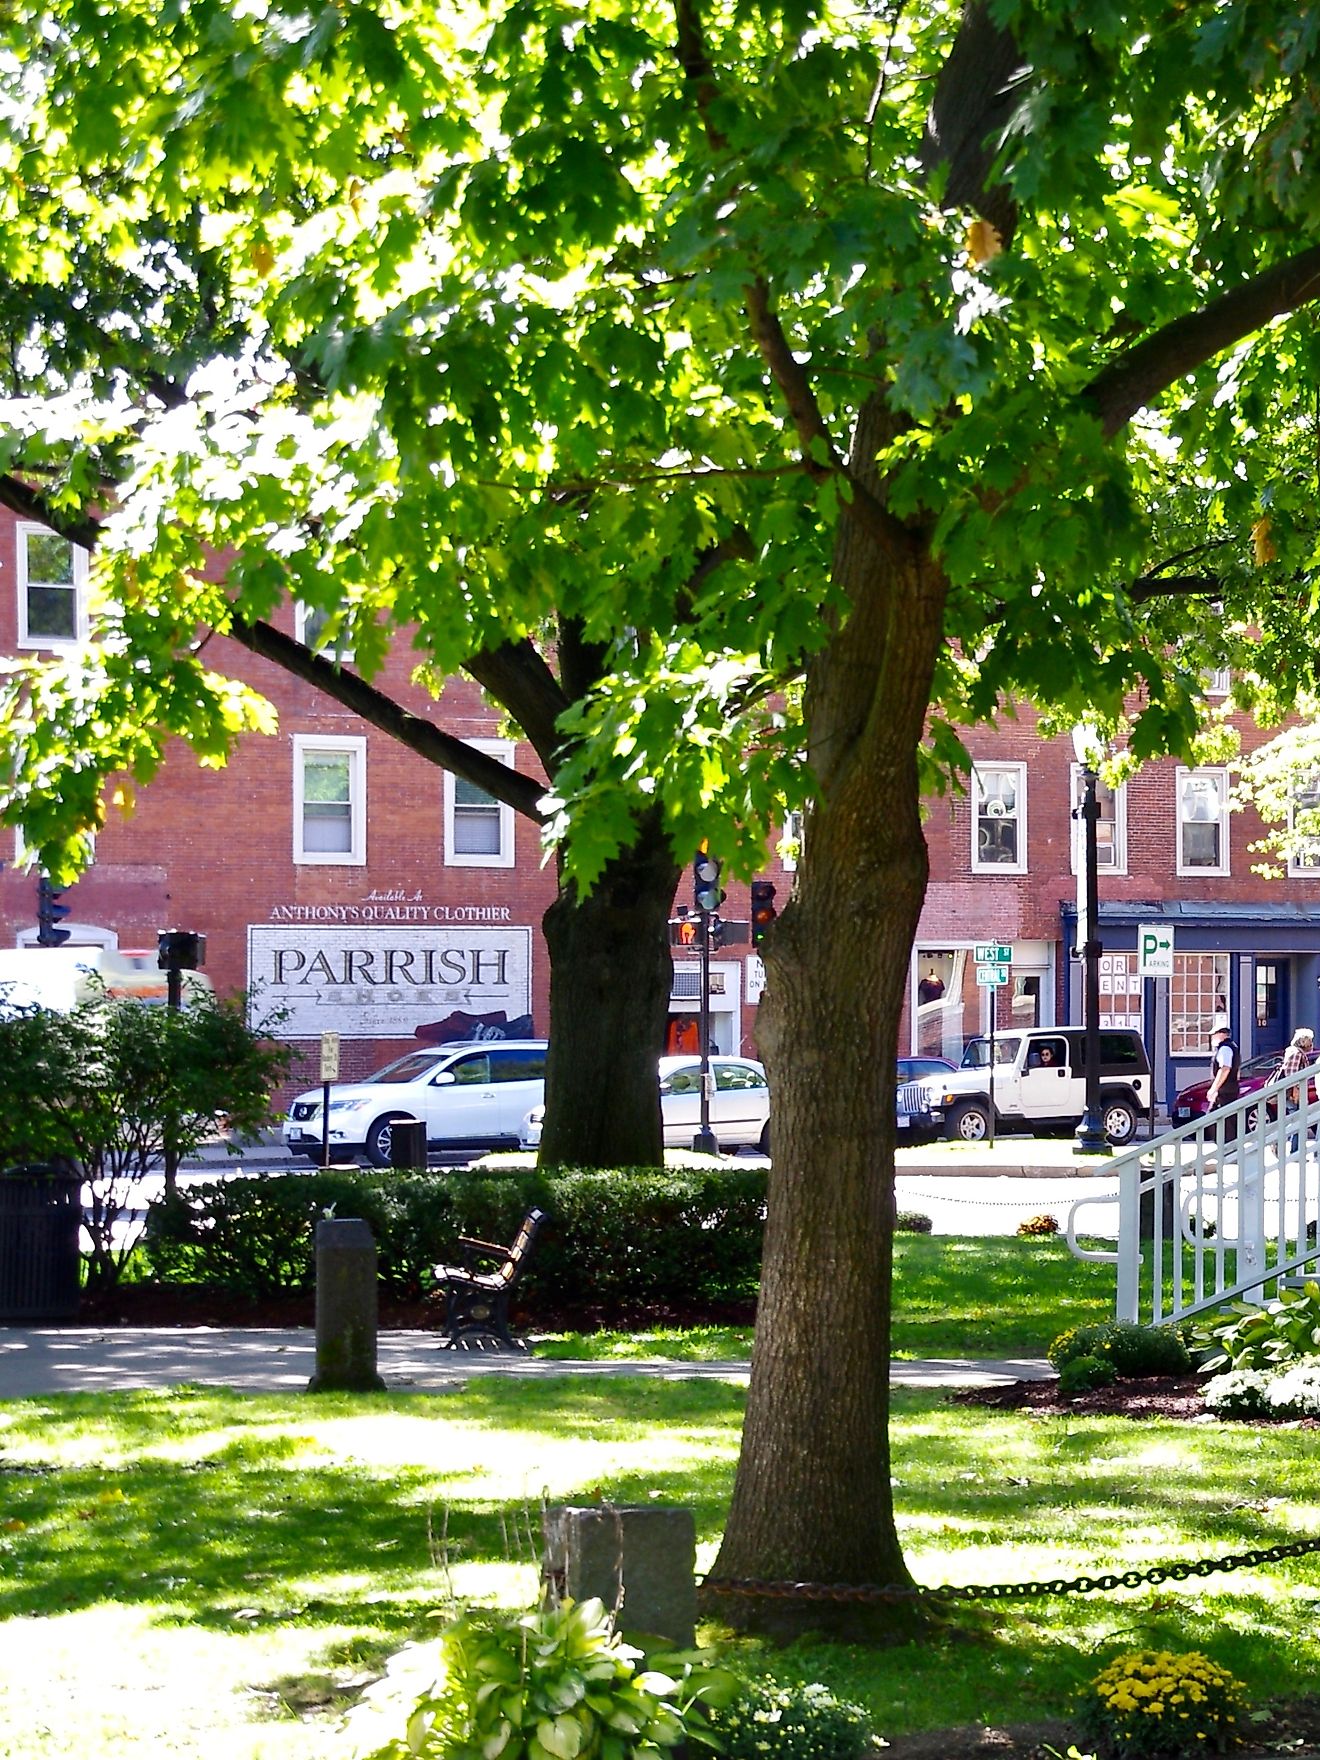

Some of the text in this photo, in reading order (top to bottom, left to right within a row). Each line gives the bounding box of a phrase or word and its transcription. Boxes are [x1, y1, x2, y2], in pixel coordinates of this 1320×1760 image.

[270, 906, 511, 921] ANTHONY'S QUALITY CLOTHIER
[977, 947, 999, 961] WEST
[270, 949, 509, 985] PARRISH
[1102, 960, 1124, 972] OR
[1102, 980, 1139, 991] ENT
